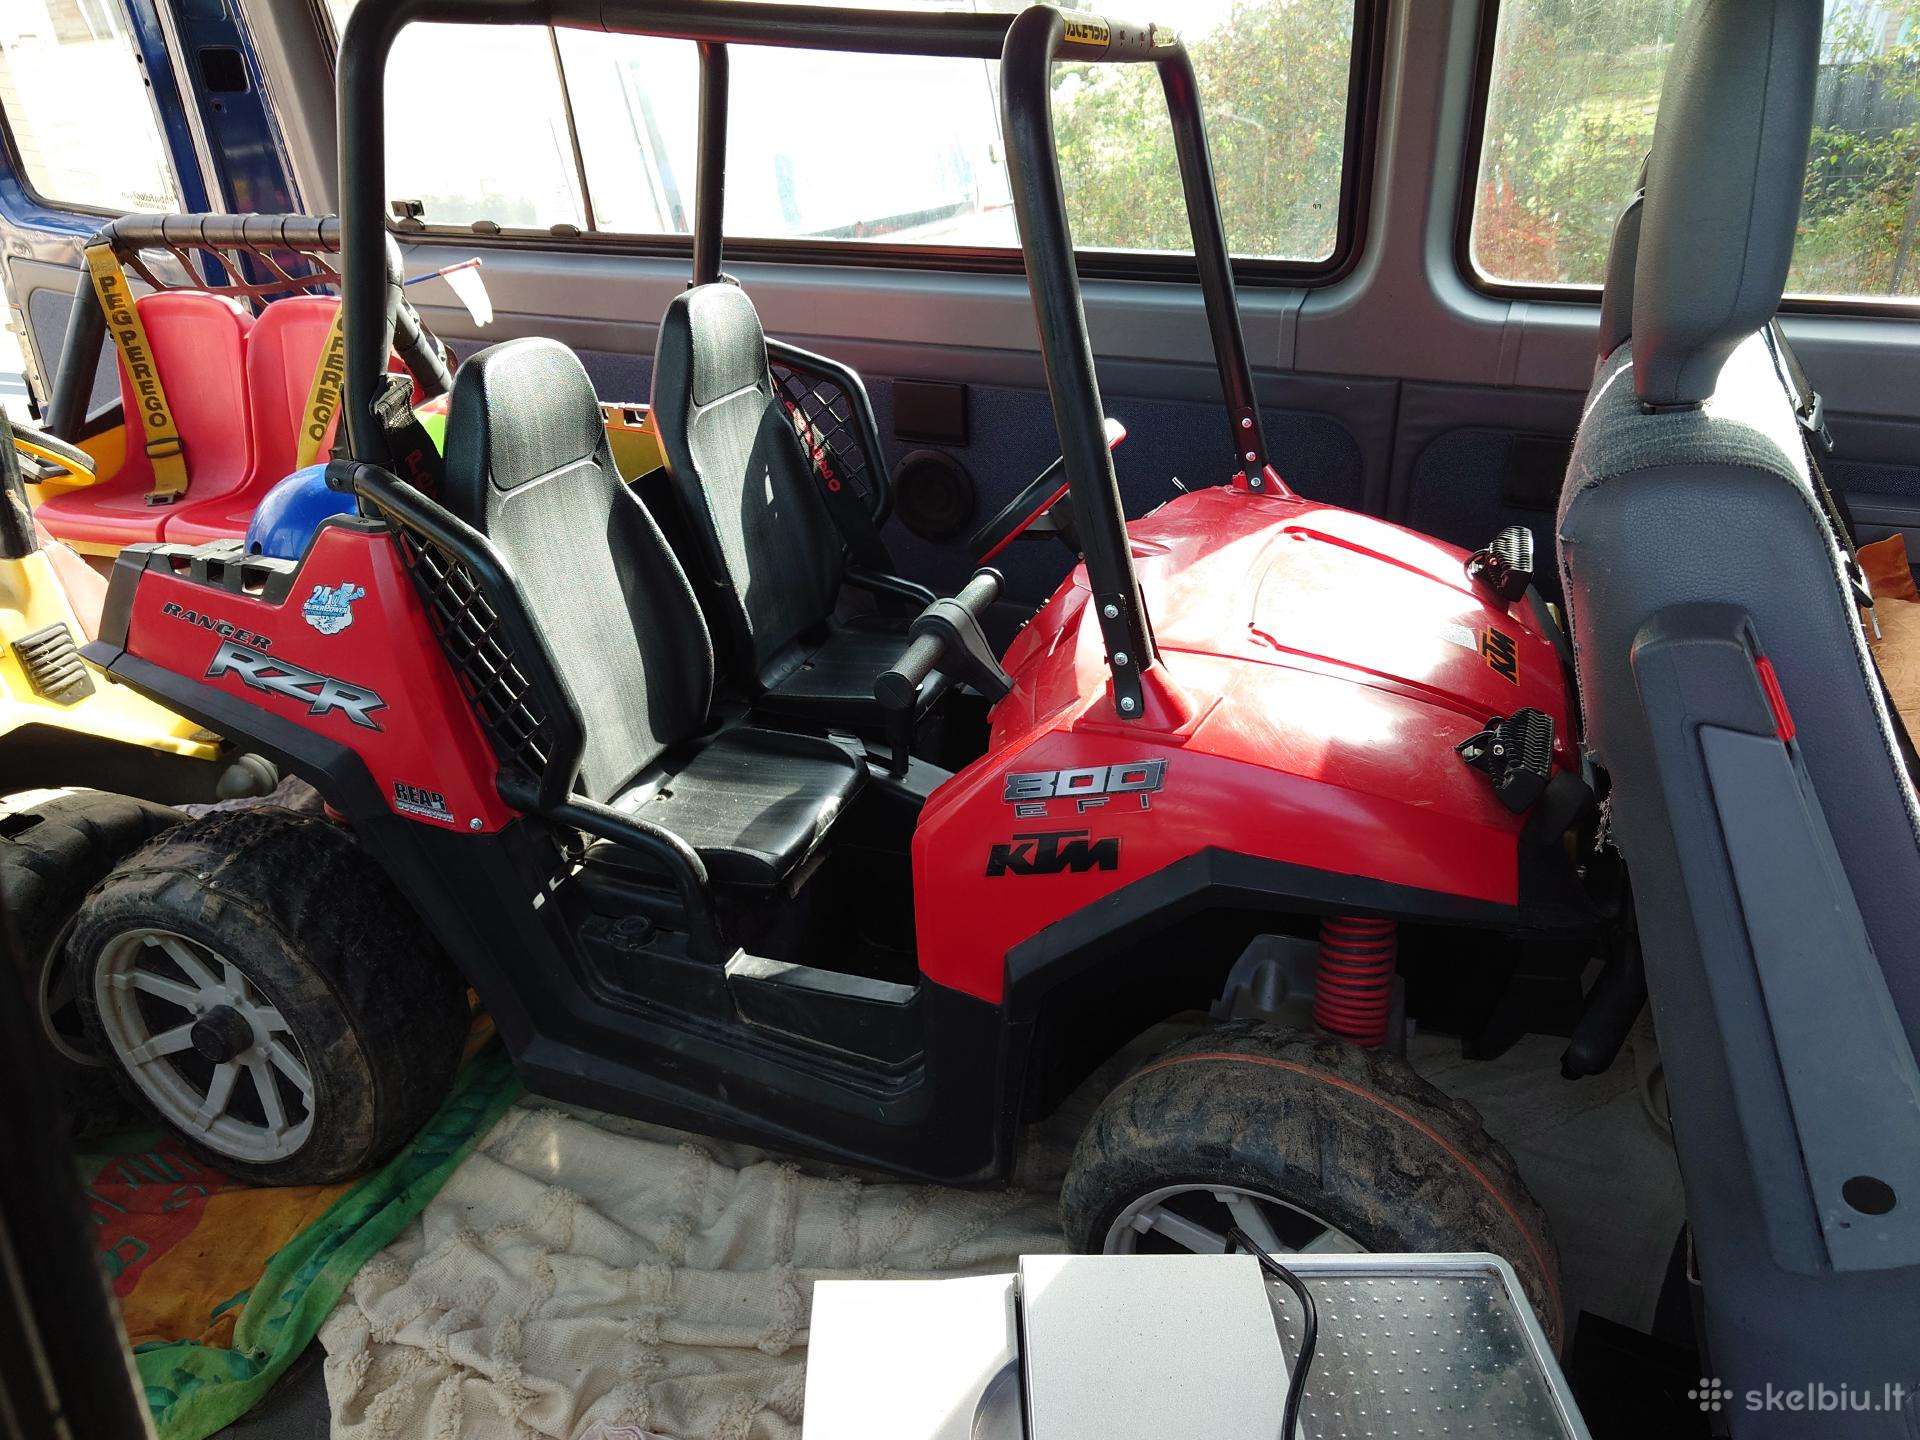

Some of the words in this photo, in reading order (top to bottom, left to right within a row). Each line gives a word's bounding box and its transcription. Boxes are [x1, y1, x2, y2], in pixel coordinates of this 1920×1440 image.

[99, 275, 133, 325] PEG
[119, 330, 167, 427] PEREGO
[310, 585, 331, 604] 24
[160, 602, 273, 650] RANGER
[1481, 626, 1519, 685] KTM
[204, 640, 389, 732] RZR
[1002, 758, 1168, 804] 800
[1014, 794, 1149, 819] EFI
[985, 829, 1121, 877] KTM
